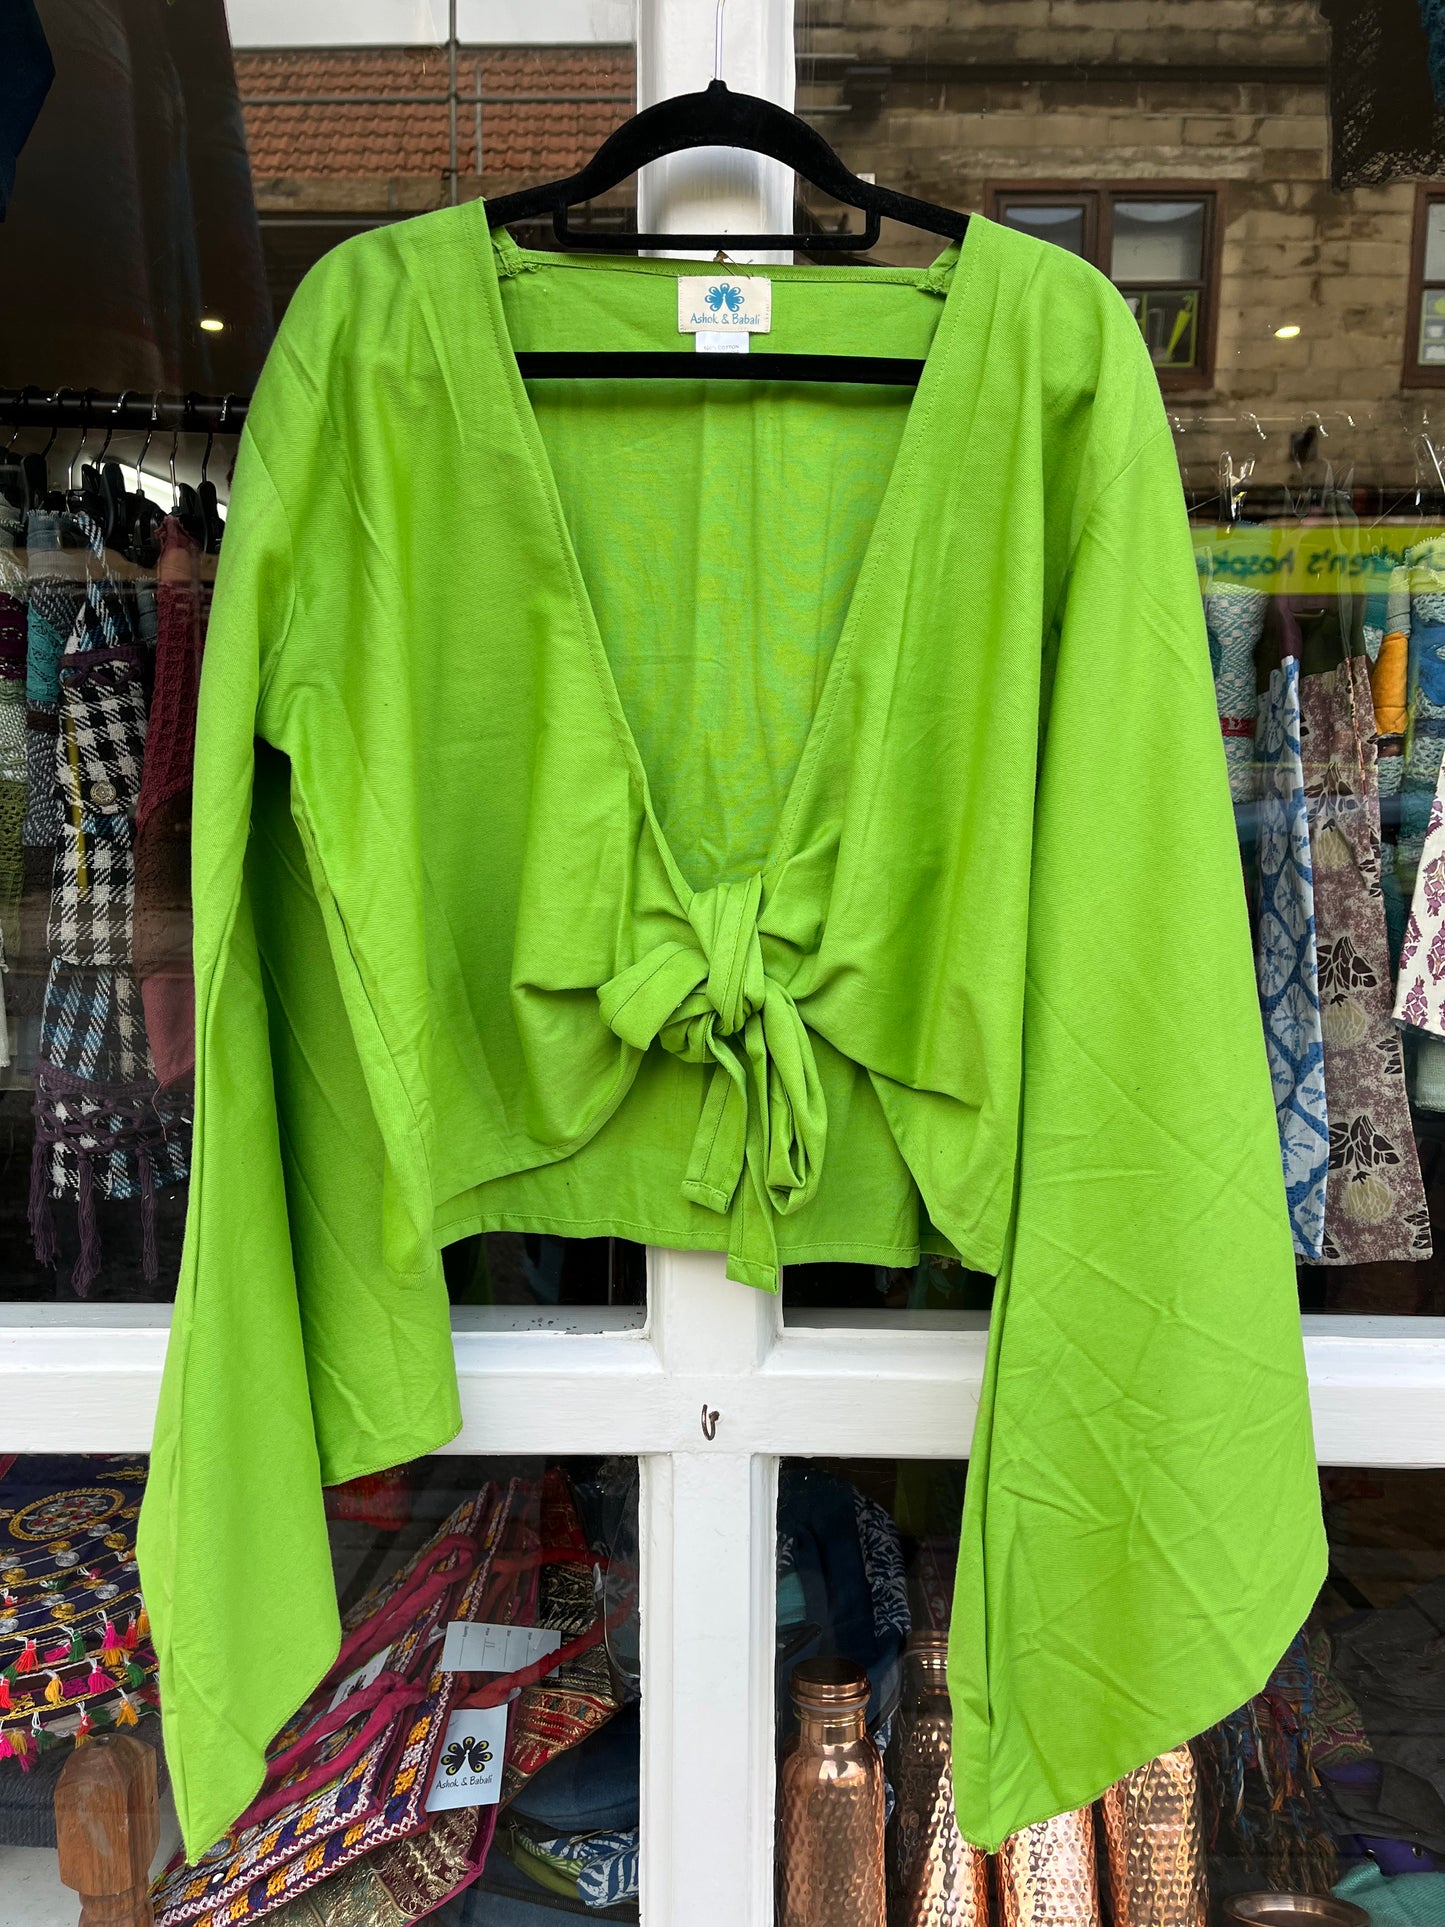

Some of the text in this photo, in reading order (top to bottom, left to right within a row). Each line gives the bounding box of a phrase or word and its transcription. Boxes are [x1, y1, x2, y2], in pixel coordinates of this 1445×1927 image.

[690, 313, 760, 325] Ashok & Babali
[436, 1774, 493, 1789] Ashok & Babali
